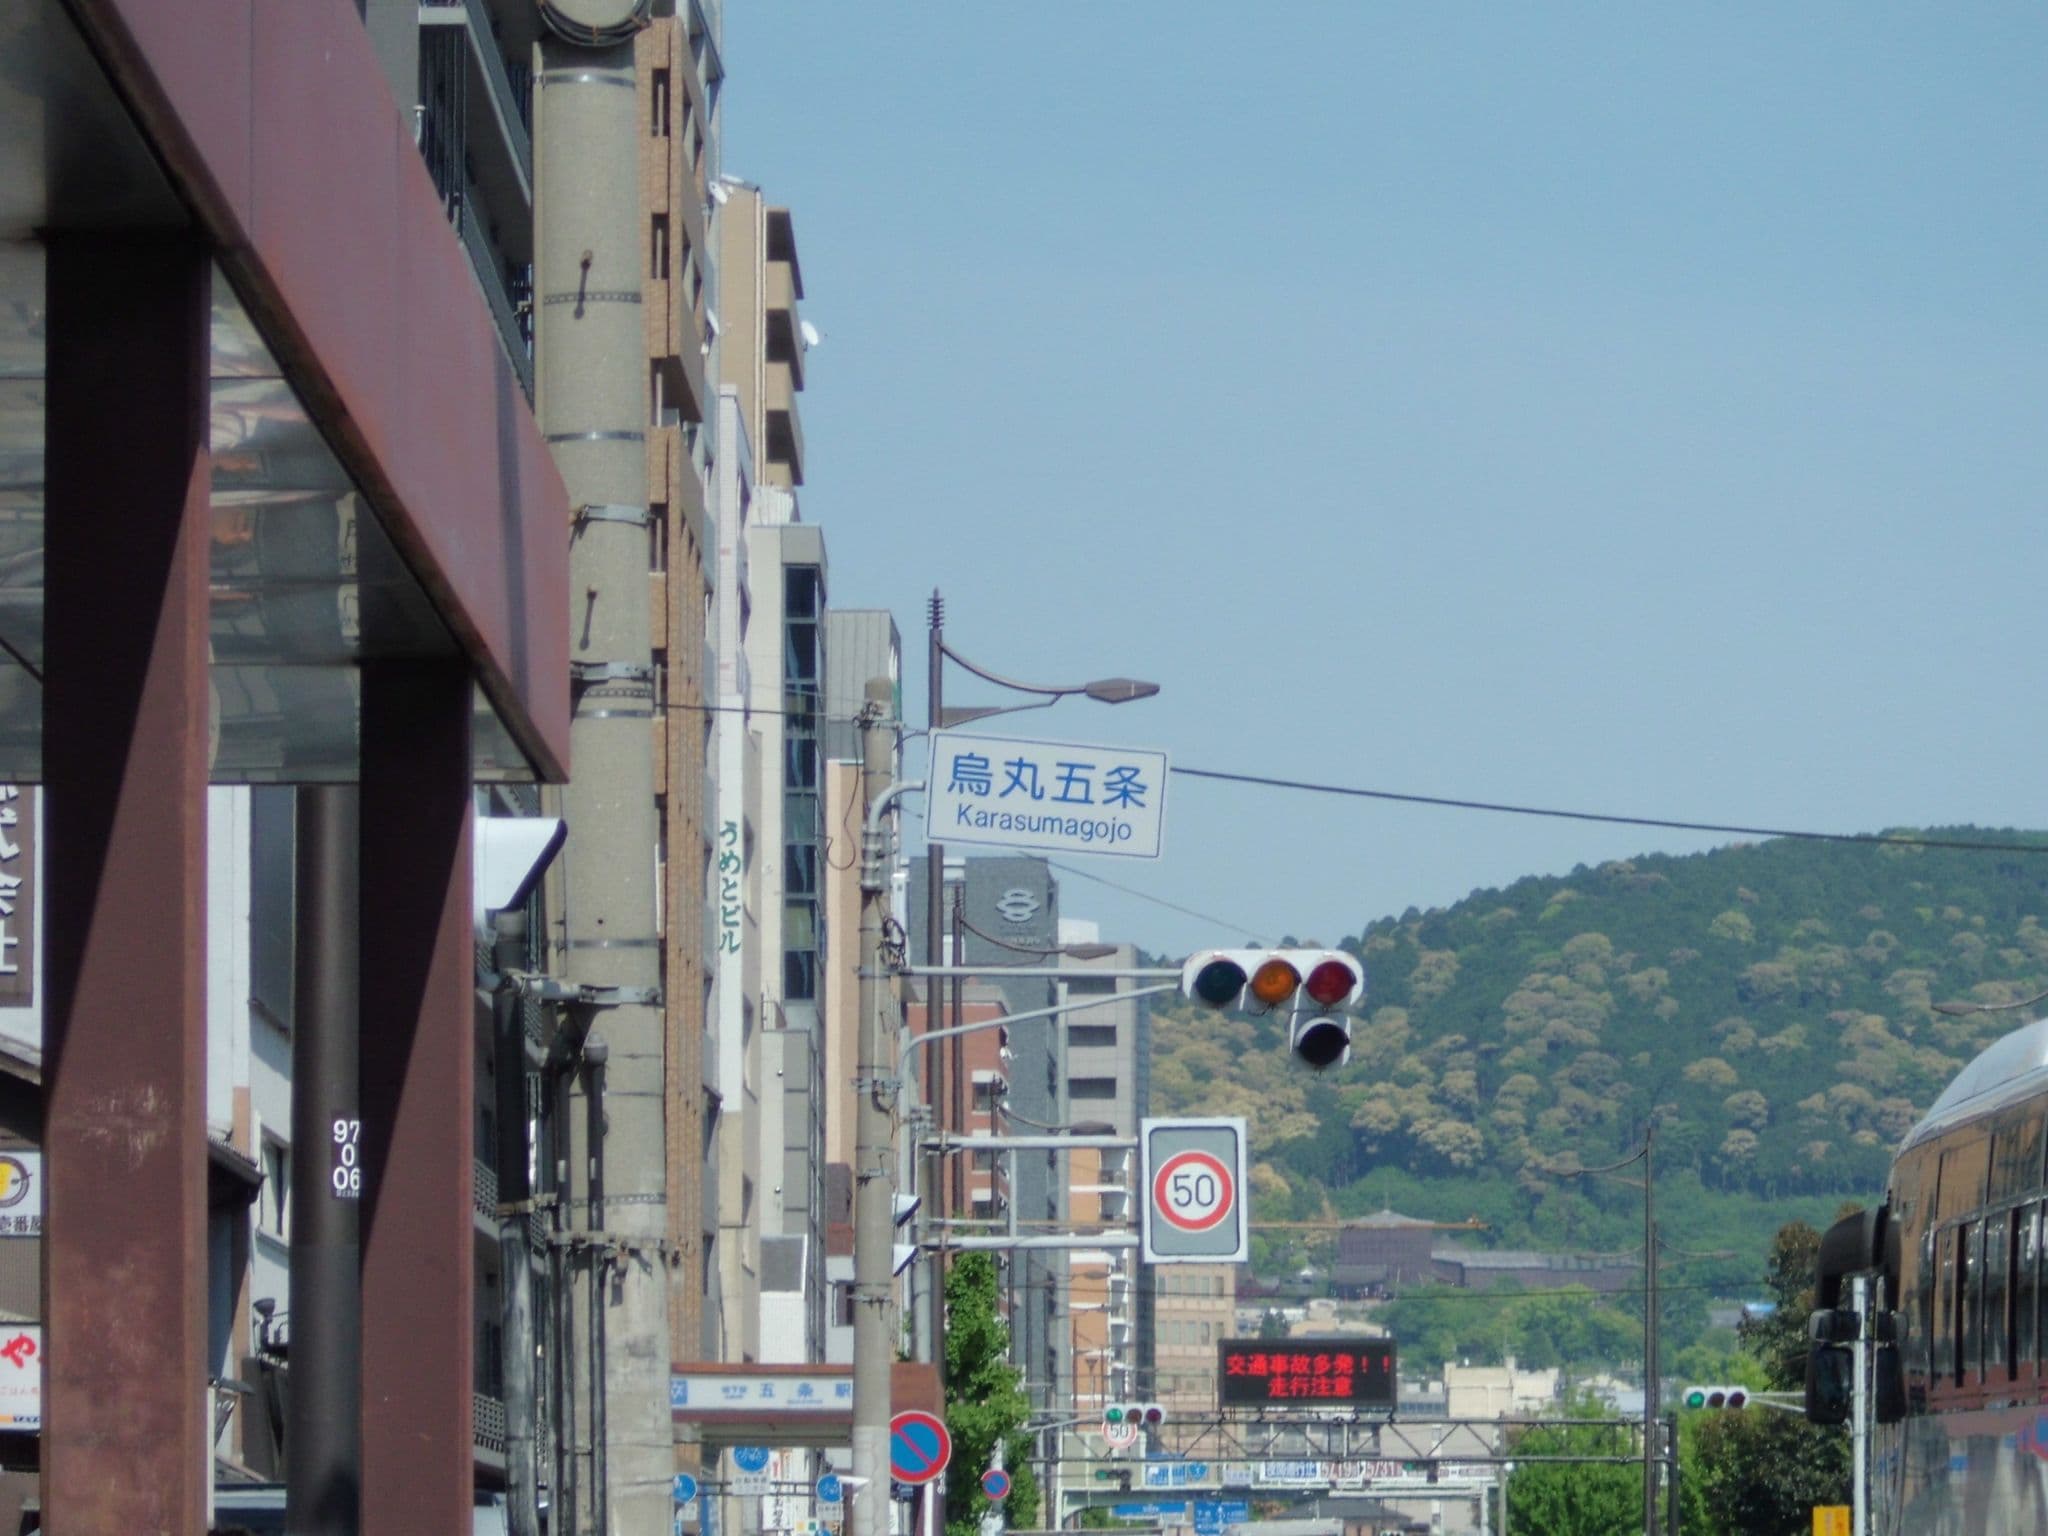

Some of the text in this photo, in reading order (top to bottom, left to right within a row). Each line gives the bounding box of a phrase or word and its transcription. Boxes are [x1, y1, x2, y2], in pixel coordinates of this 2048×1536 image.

[947, 751, 1148, 810] 烏丸五条
[956, 803, 1133, 844] Karasumagojo
[719, 820, 742, 954] うめとビル
[333, 1119, 360, 1144] 97
[341, 1143, 355, 1167] 0
[333, 1166, 360, 1190] 06
[1173, 1173, 1216, 1208] 50
[0, 1333, 42, 1369] や
[1268, 1376, 1353, 1397] 走行注意
